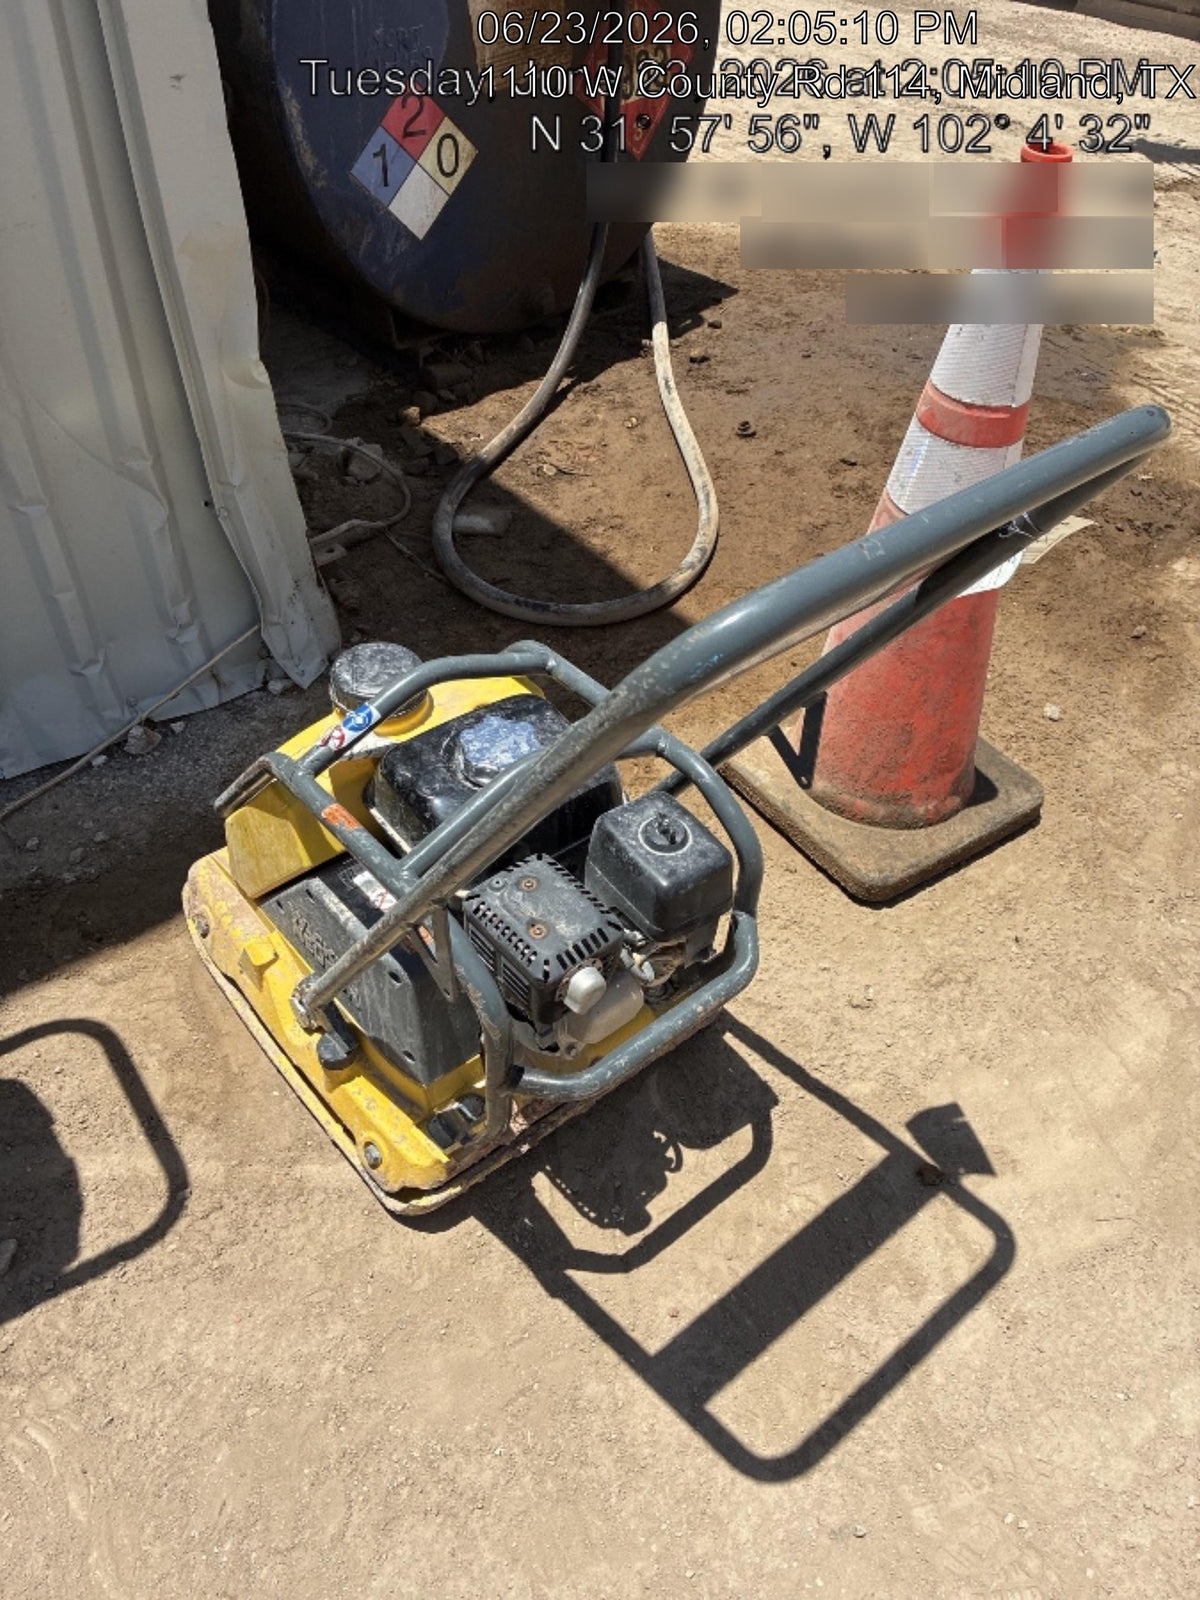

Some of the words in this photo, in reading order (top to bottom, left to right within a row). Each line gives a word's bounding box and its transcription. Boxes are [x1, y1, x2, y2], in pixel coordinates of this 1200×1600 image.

[401, 91, 426, 138] 2
[372, 143, 389, 187] 1
[436, 132, 459, 178] 0
